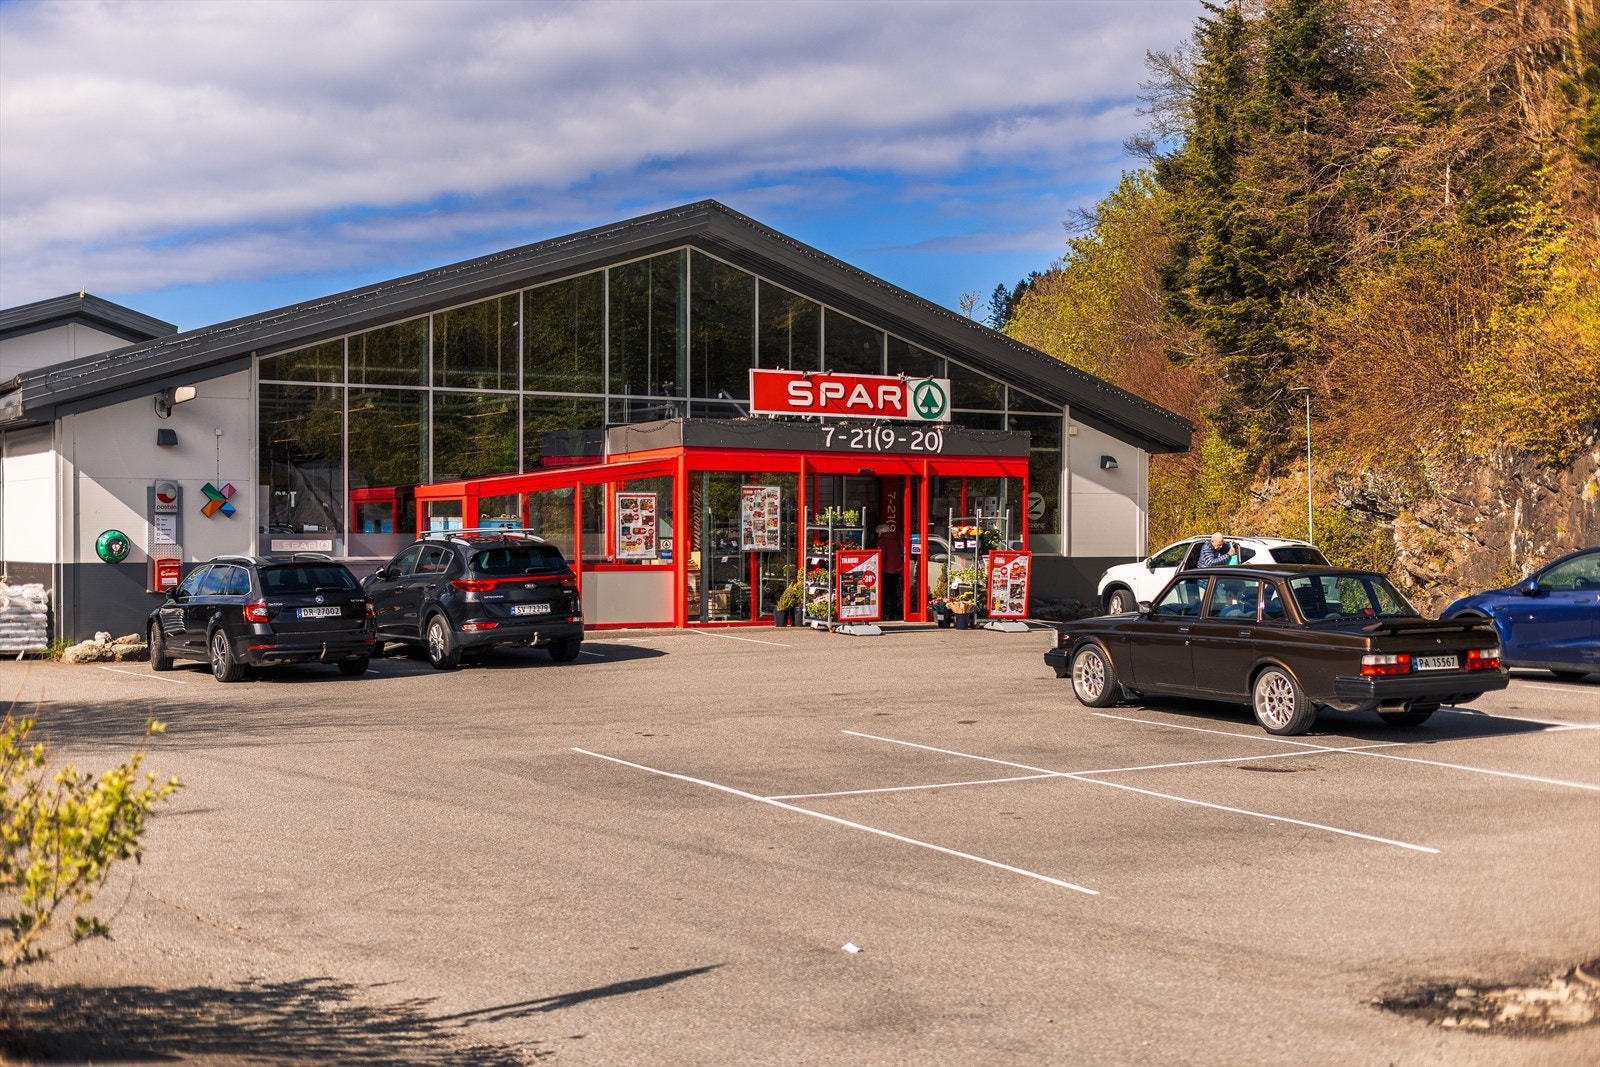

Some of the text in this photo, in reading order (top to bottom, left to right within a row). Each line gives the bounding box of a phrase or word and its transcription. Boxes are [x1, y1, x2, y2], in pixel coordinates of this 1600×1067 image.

[787, 380, 902, 410] SPAR
[282, 541, 316, 549] SPAR
[303, 607, 340, 616] DR 27002
[1419, 656, 1455, 668] PA 15567
